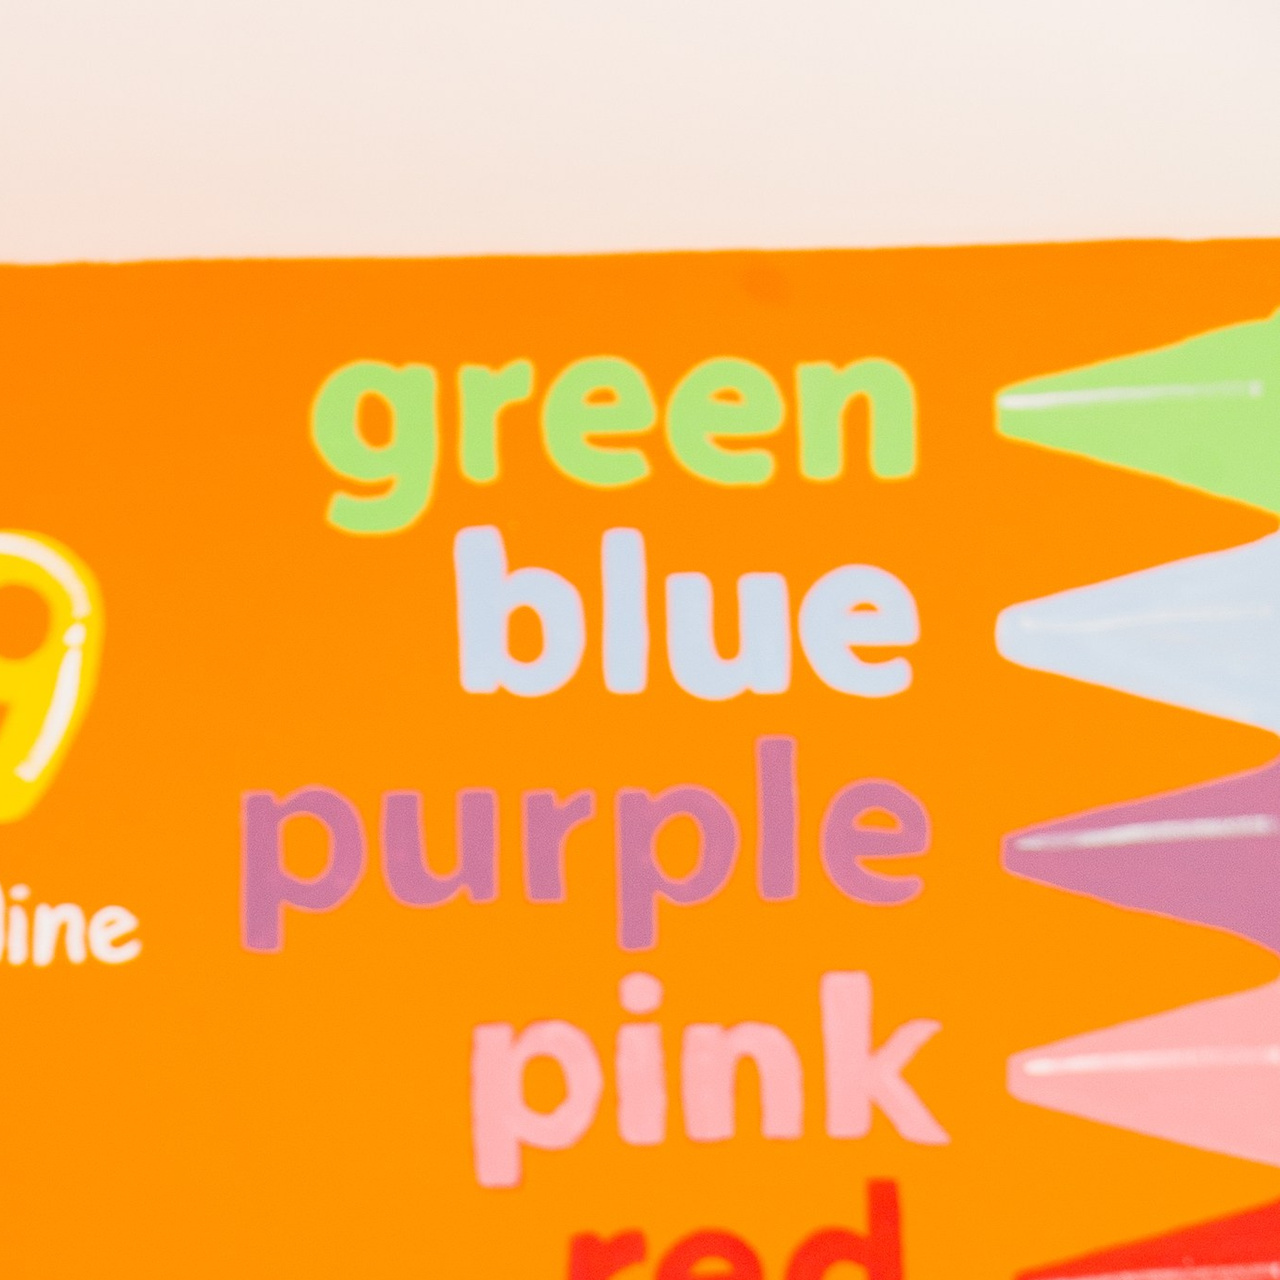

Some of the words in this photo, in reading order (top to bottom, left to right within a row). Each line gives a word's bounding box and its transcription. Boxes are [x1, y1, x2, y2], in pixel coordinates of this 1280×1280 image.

[311, 356, 918, 534] green
[452, 524, 921, 702] blue
[240, 734, 931, 953] purple
[471, 971, 951, 1188] pink
